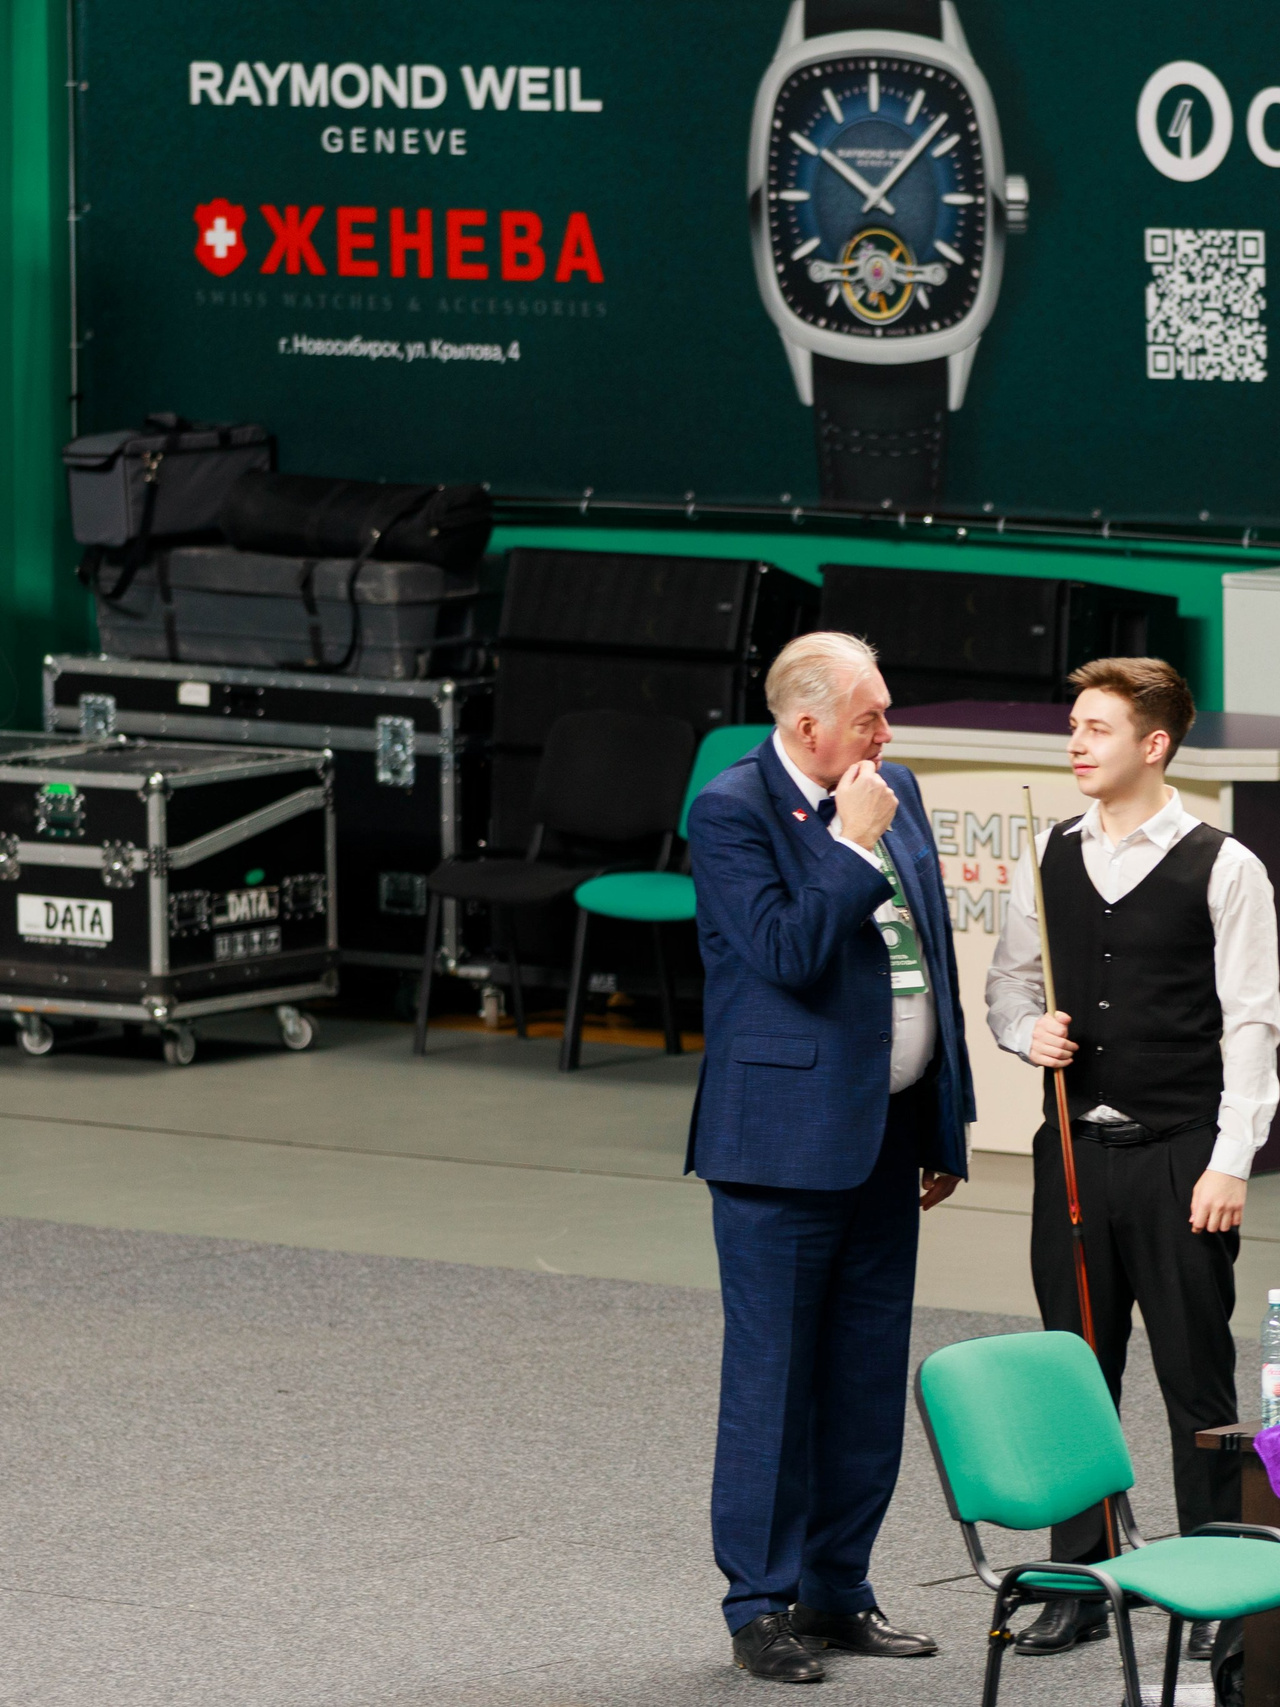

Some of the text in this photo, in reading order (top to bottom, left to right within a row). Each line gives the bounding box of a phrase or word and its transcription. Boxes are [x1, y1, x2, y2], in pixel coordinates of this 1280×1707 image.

[189, 61, 603, 112] RAYMOND WEIL
[320, 126, 468, 156] GENEVE
[258, 203, 605, 284] ЖЕНЕВА
[43, 901, 104, 935] DATA
